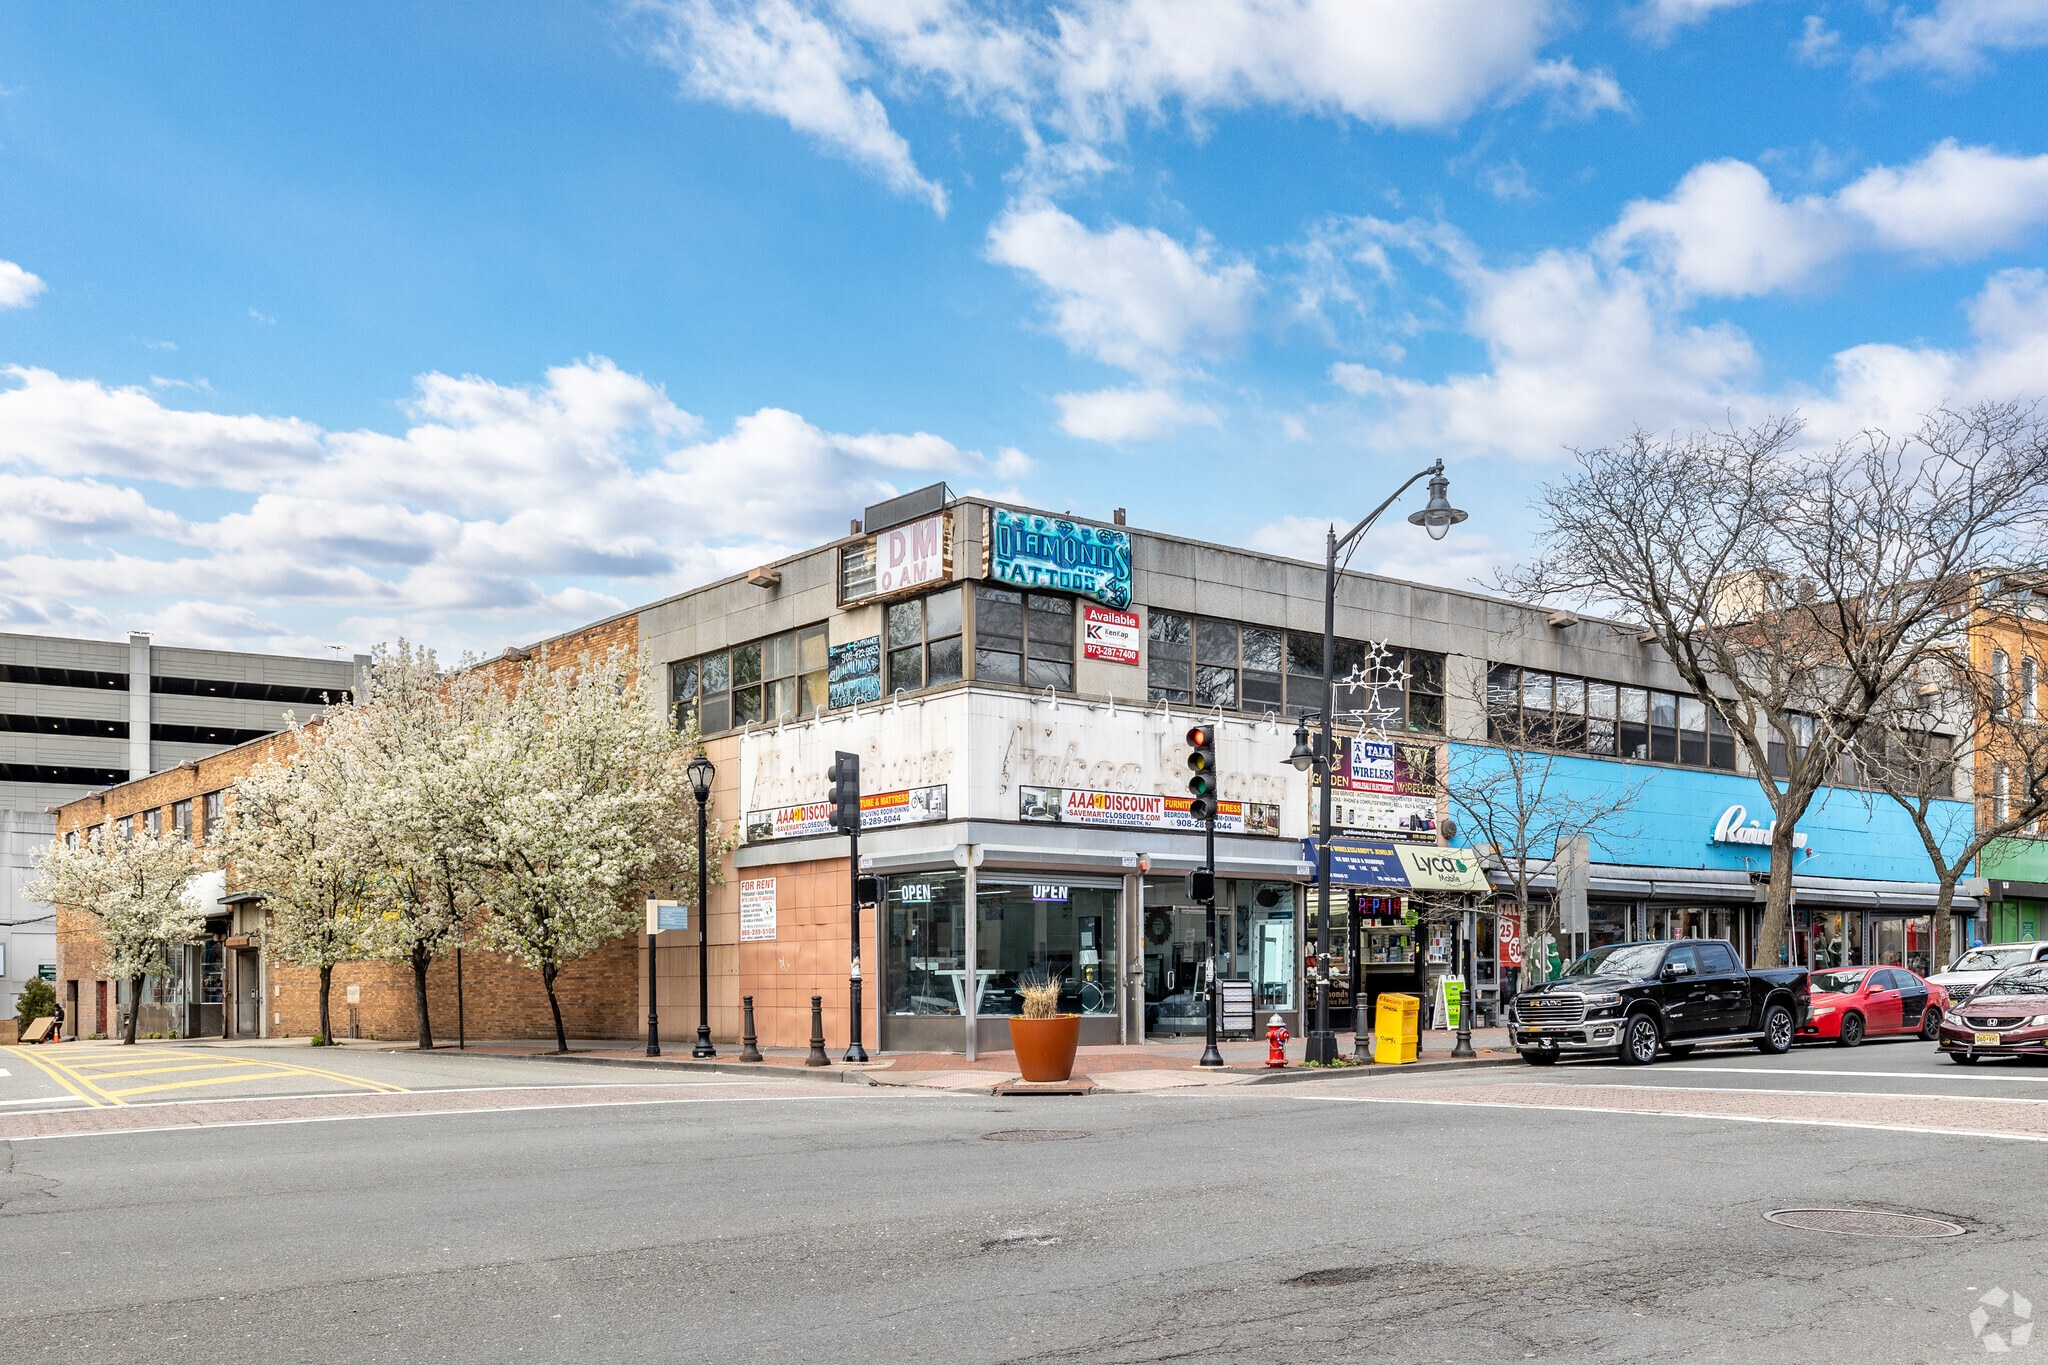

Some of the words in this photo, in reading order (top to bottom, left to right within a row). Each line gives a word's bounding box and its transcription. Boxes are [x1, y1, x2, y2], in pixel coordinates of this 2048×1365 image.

[996, 560, 1096, 591] TATTOOS
[1090, 609, 1136, 626] Available
[1087, 644, 1136, 660] 973-287-7400
[1366, 746, 1390, 758] TALK
[1352, 766, 1394, 780] WIRELESS
[1396, 781, 1436, 796] WIRELESS
[881, 793, 908, 805] MATTRESS
[1068, 792, 1095, 809] AAA
[1105, 794, 1161, 813] DISCOUNT
[776, 808, 795, 824] AAA
[1069, 809, 1161, 821] SAVEMARTCLOSEOUTS.COM
[1412, 853, 1457, 875] Lyca
[741, 881, 754, 890] FOR
[757, 879, 774, 889] RENT
[1438, 874, 1461, 882] Mobile
[901, 884, 931, 900] OPEN
[1032, 885, 1068, 899] OPEN
[1359, 897, 1401, 915] REPAIR
[1499, 904, 1520, 916] SAL
[1500, 923, 1511, 937] 25
[1511, 943, 1521, 957] 50
